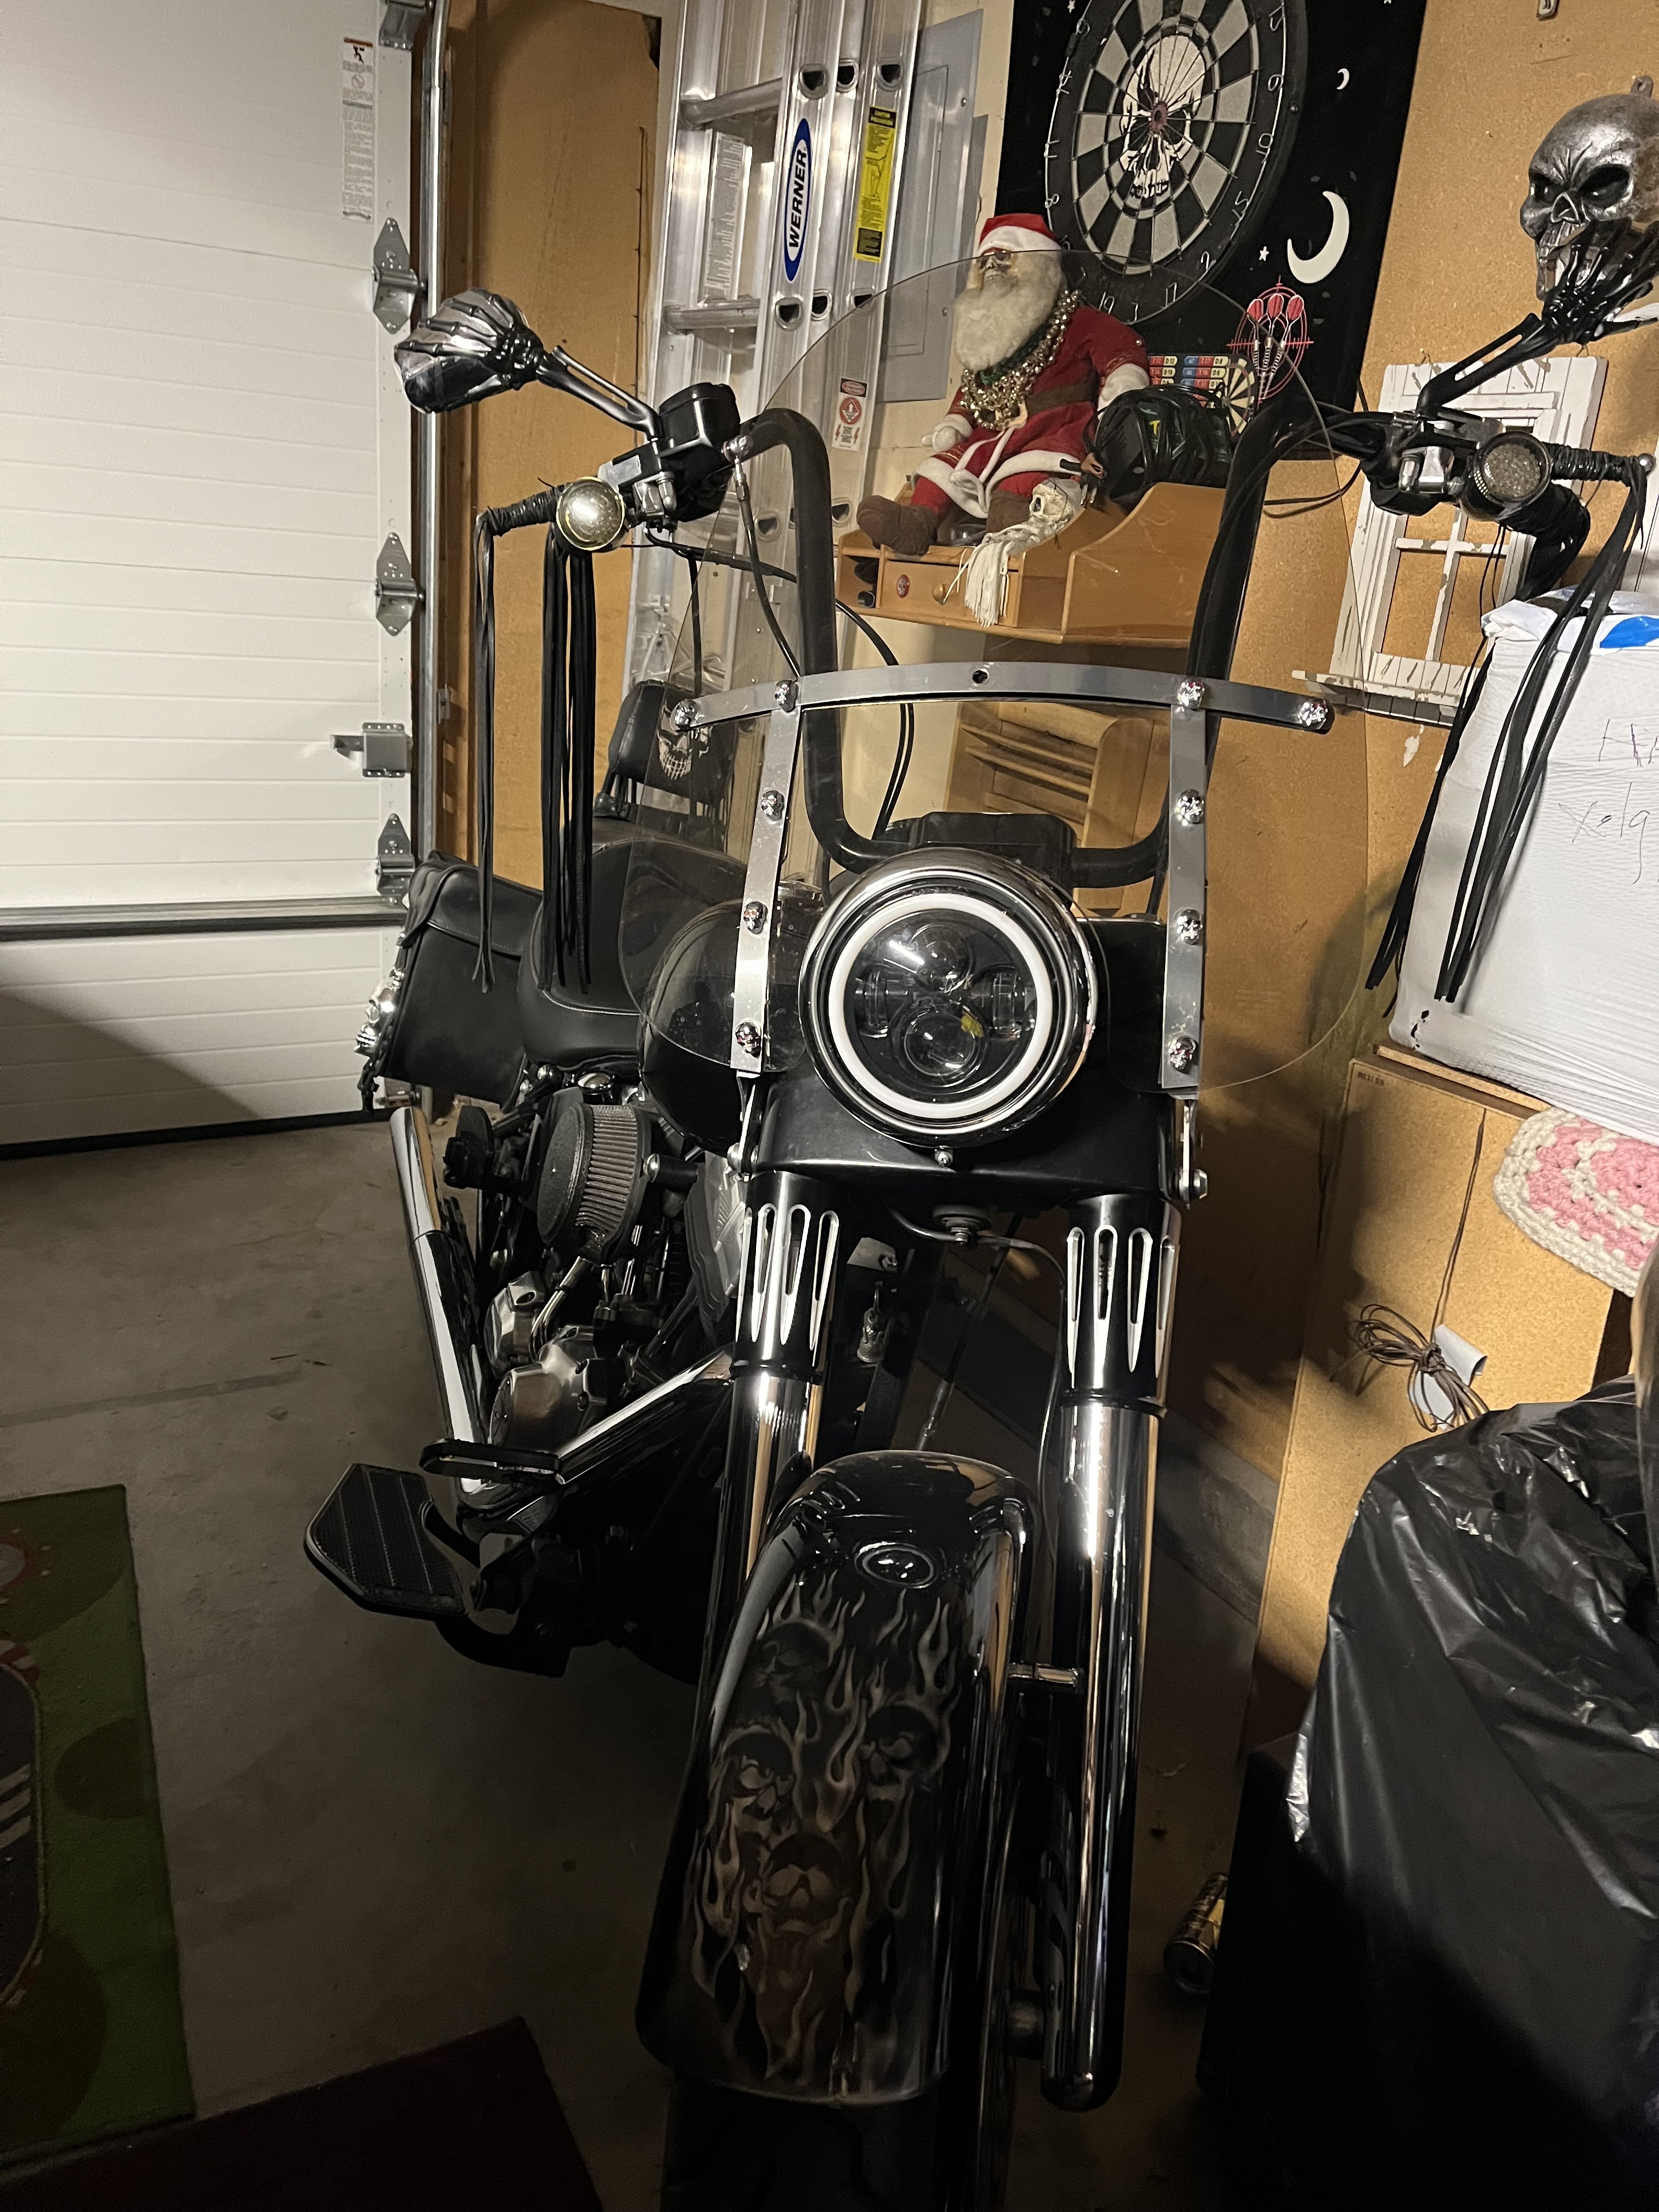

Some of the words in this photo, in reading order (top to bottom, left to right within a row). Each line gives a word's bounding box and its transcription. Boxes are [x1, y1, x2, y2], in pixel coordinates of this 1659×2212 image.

[1255, 133, 1273, 164] 10
[789, 148, 808, 247] WERNER
[1098, 291, 1115, 314] 19
